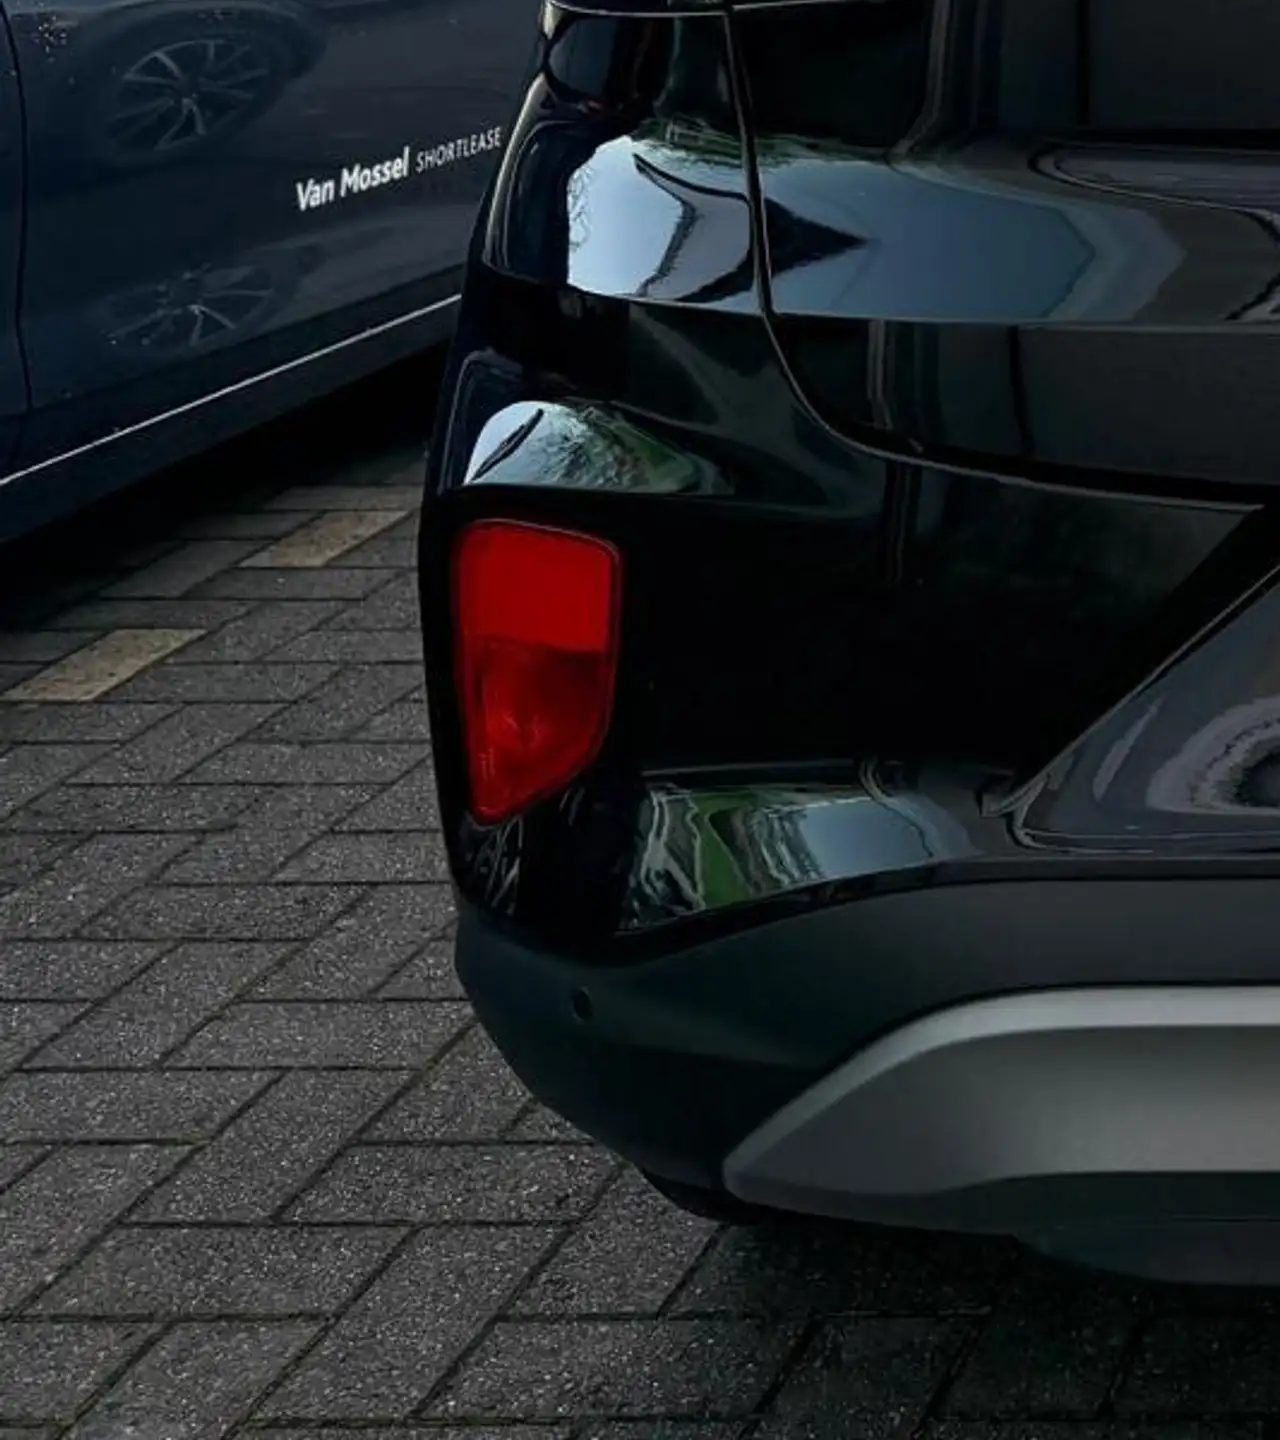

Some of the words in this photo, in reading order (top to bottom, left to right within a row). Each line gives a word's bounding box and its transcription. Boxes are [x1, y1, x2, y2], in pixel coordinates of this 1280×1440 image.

[296, 177, 335, 211] Van
[340, 145, 410, 198] Mossel
[415, 127, 502, 173] SHORTLEASE
